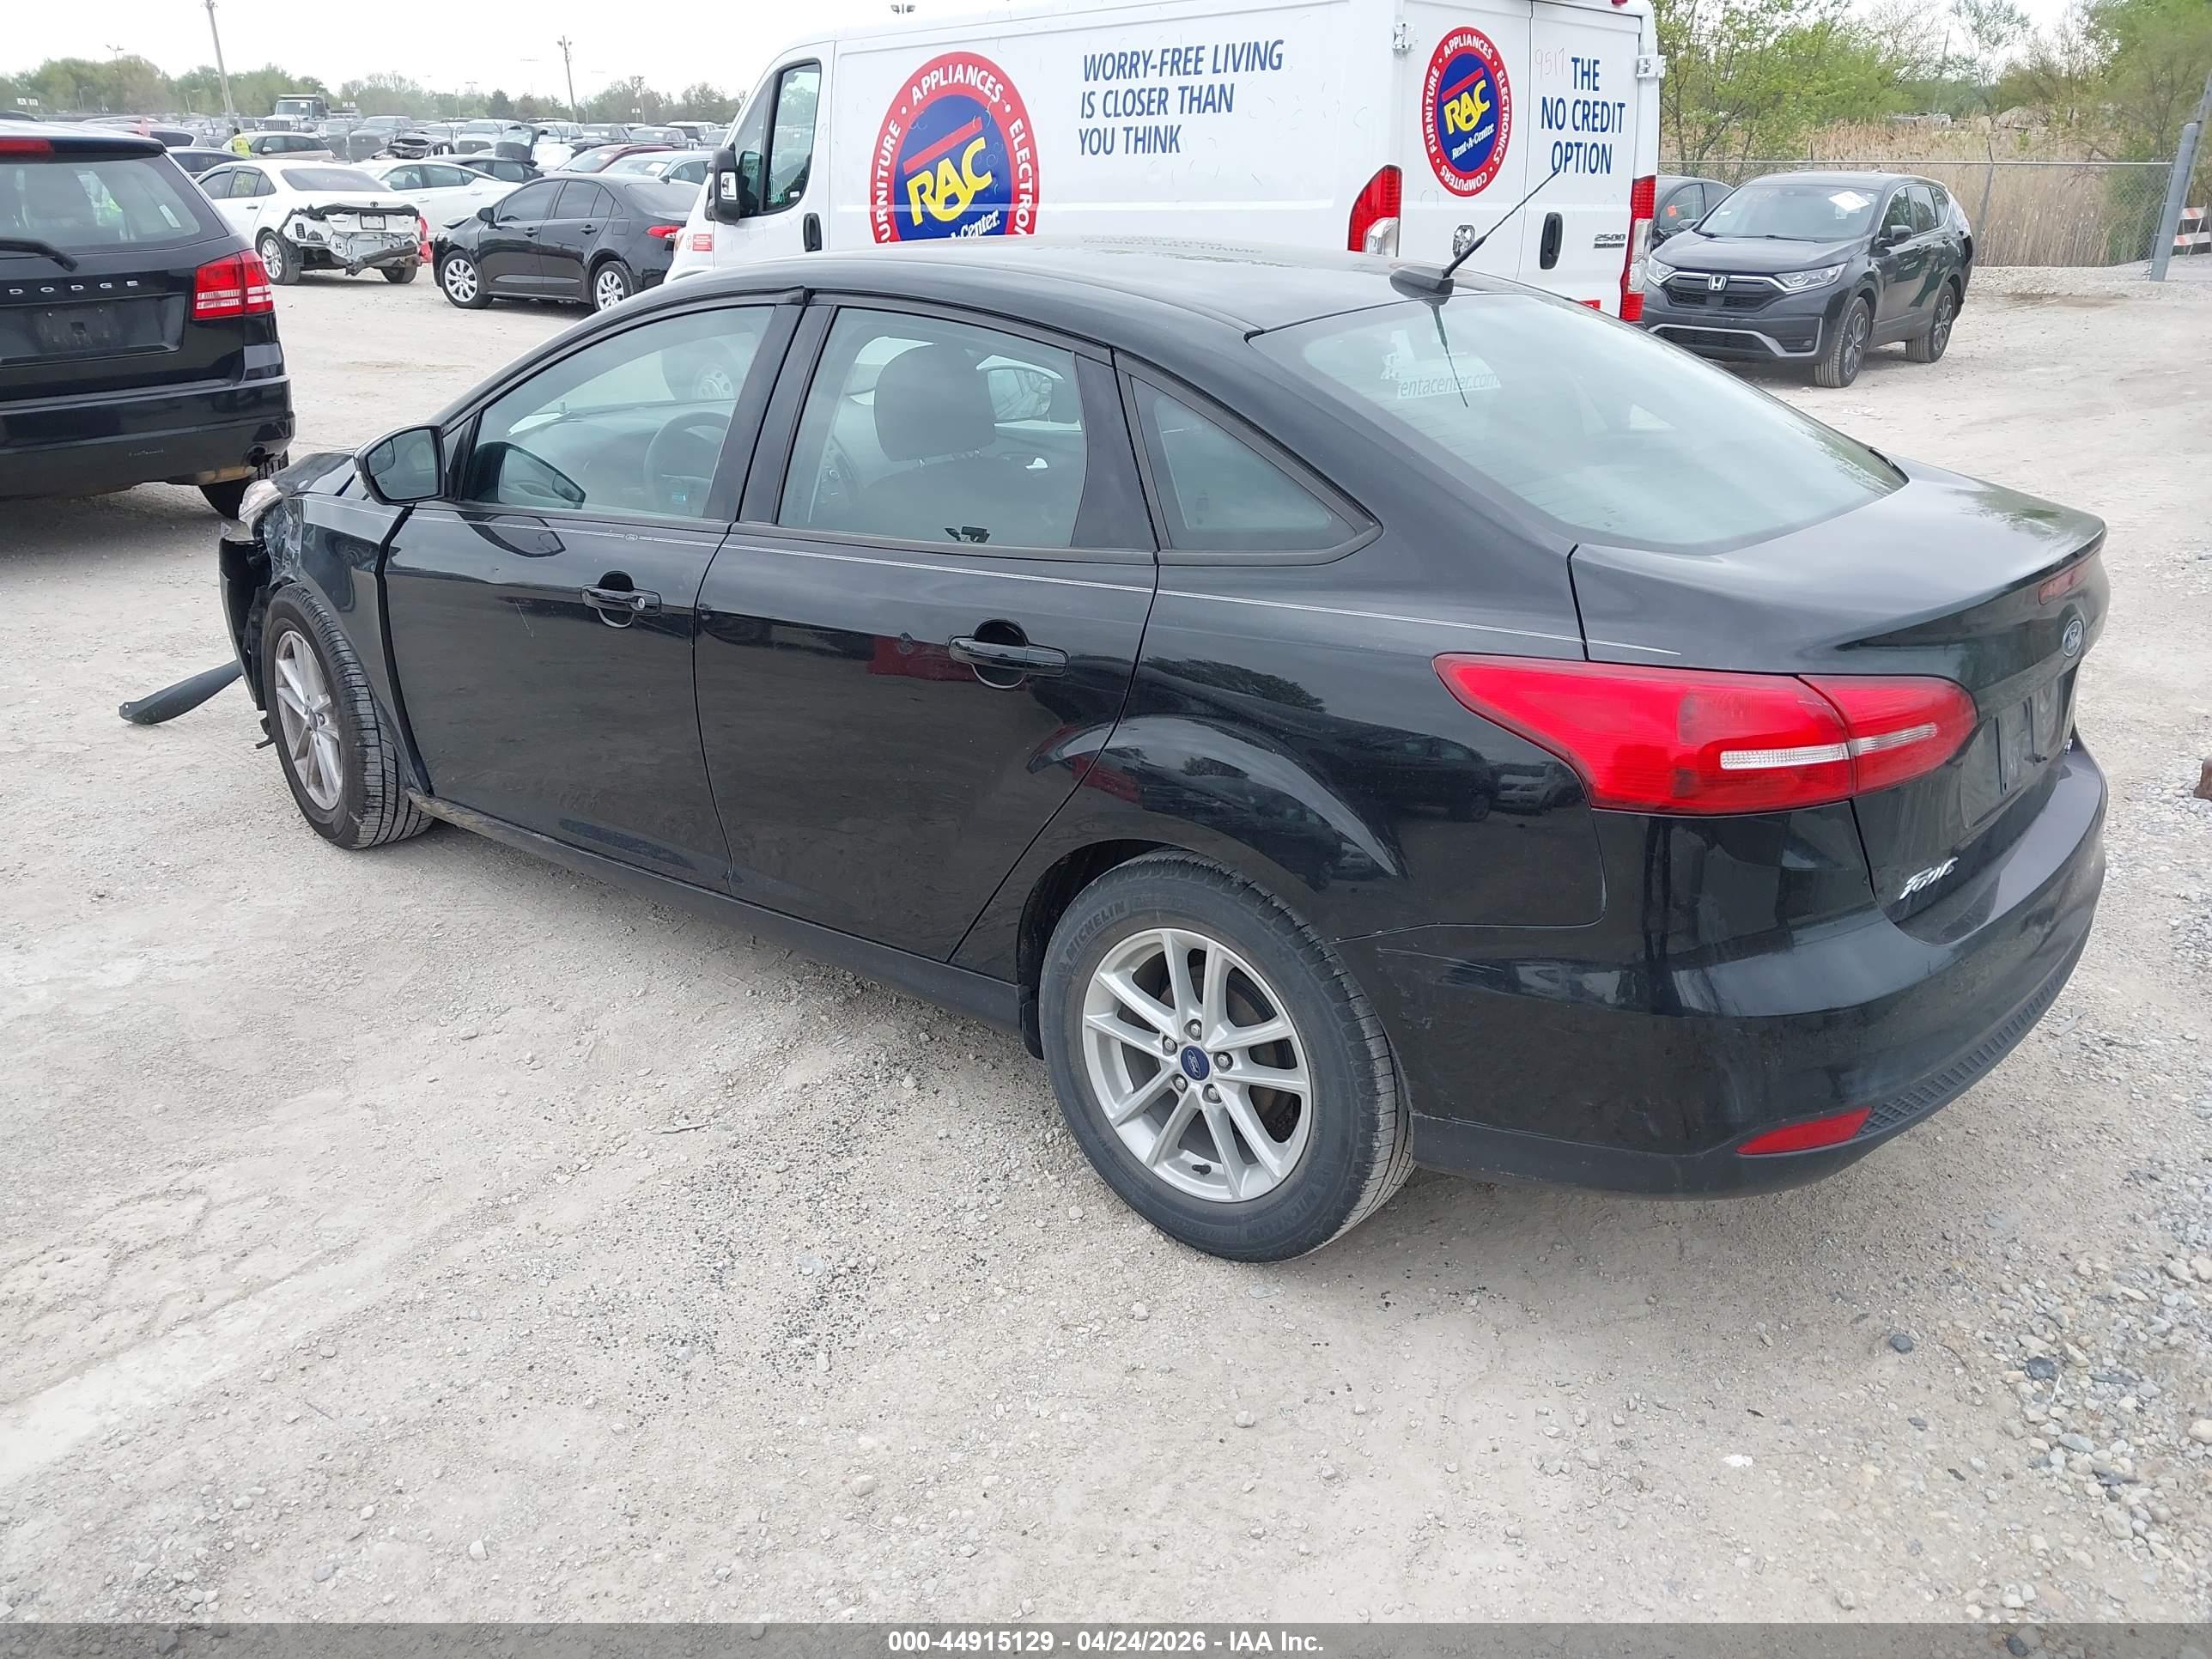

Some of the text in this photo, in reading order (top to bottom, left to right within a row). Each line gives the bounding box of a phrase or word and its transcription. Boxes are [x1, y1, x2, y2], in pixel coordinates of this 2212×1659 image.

[1083, 39, 1285, 82] WORRY-FREE LIVING
[1443, 33, 1493, 60] APPLIANCES
[911, 64, 1004, 106] APPLIANCES
[1571, 57, 1601, 91] THE
[1080, 83, 1234, 119] IS CLOSER THAN
[1425, 66, 1440, 155] FURNITURE
[1443, 79, 1491, 135] RAC
[1493, 69, 1510, 166] ELECTRONICS
[1540, 96, 1626, 134] NO CREDIT
[1078, 125, 1182, 155] YOU THINK
[1551, 140, 1613, 175] OPTION
[876, 119, 902, 242] URNITURE
[907, 137, 994, 227] RAC
[1440, 165, 1487, 191] COMPUTERS
[8, 280, 139, 295] DODGE
